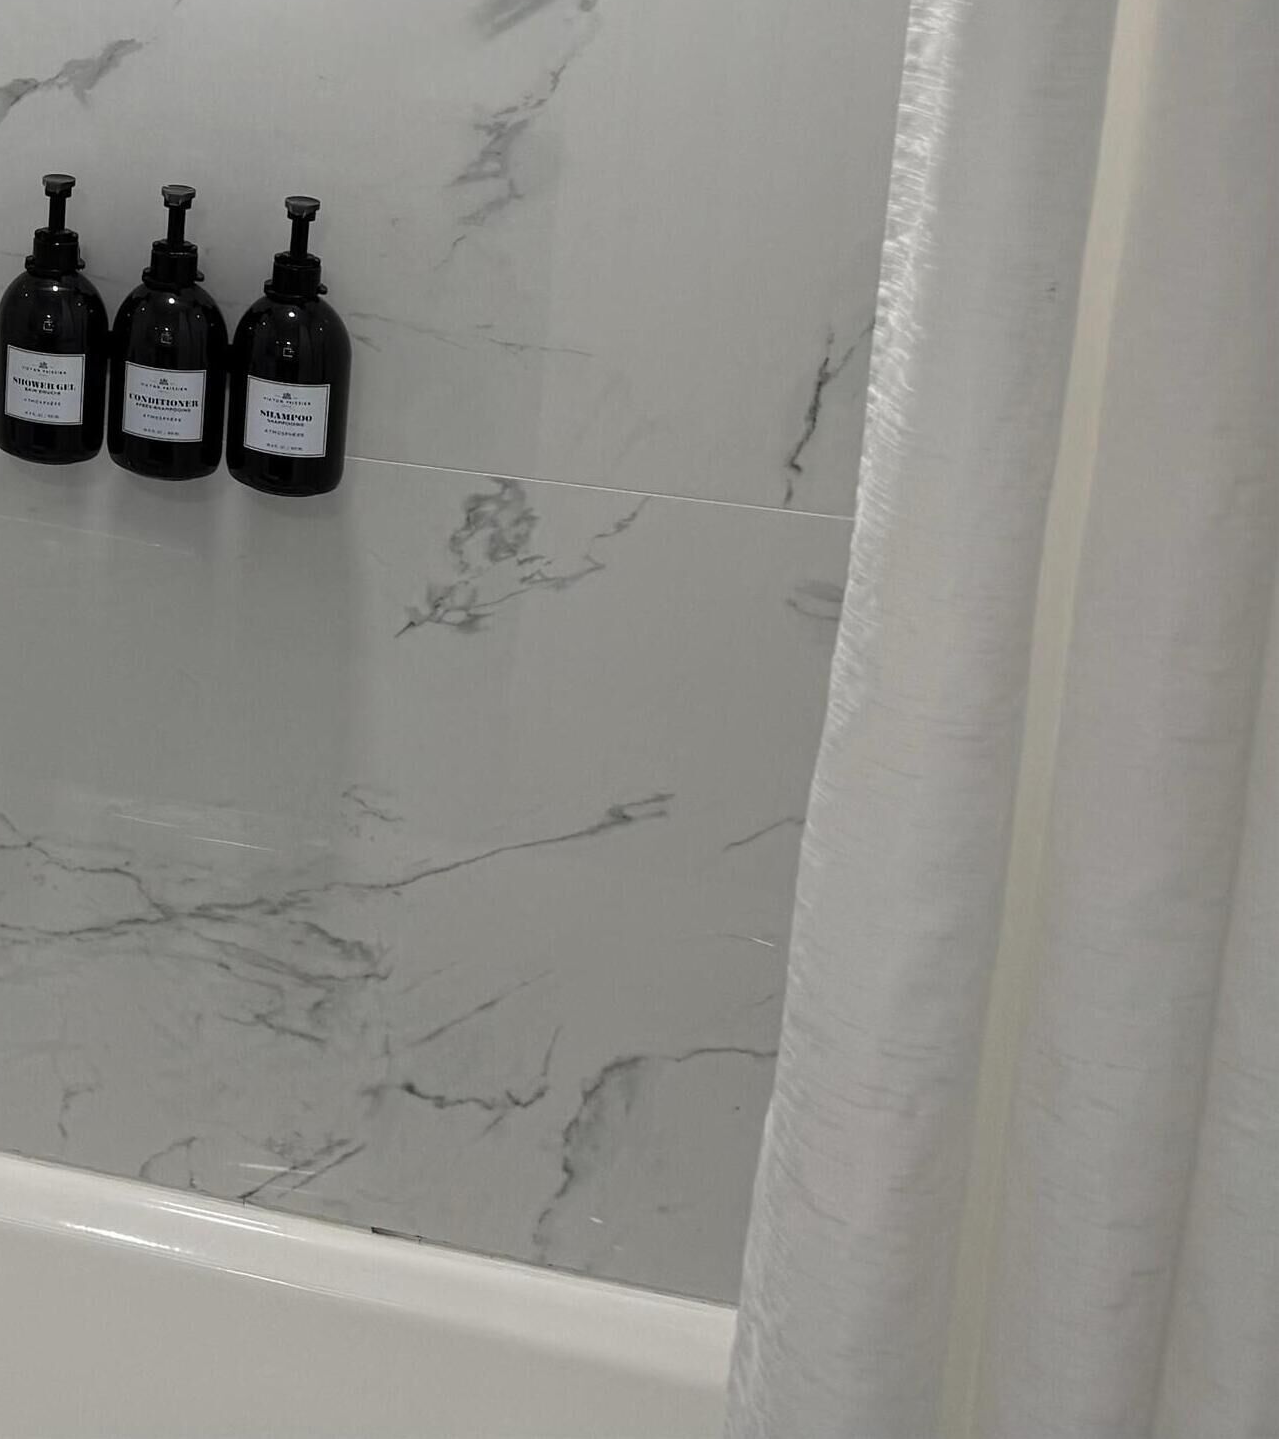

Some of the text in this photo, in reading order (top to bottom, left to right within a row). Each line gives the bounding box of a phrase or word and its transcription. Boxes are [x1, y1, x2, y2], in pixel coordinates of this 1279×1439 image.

[12, 376, 76, 391] SHOWER GEL
[128, 393, 199, 408] CONDITIONER
[260, 409, 313, 422] SHAMPOO
